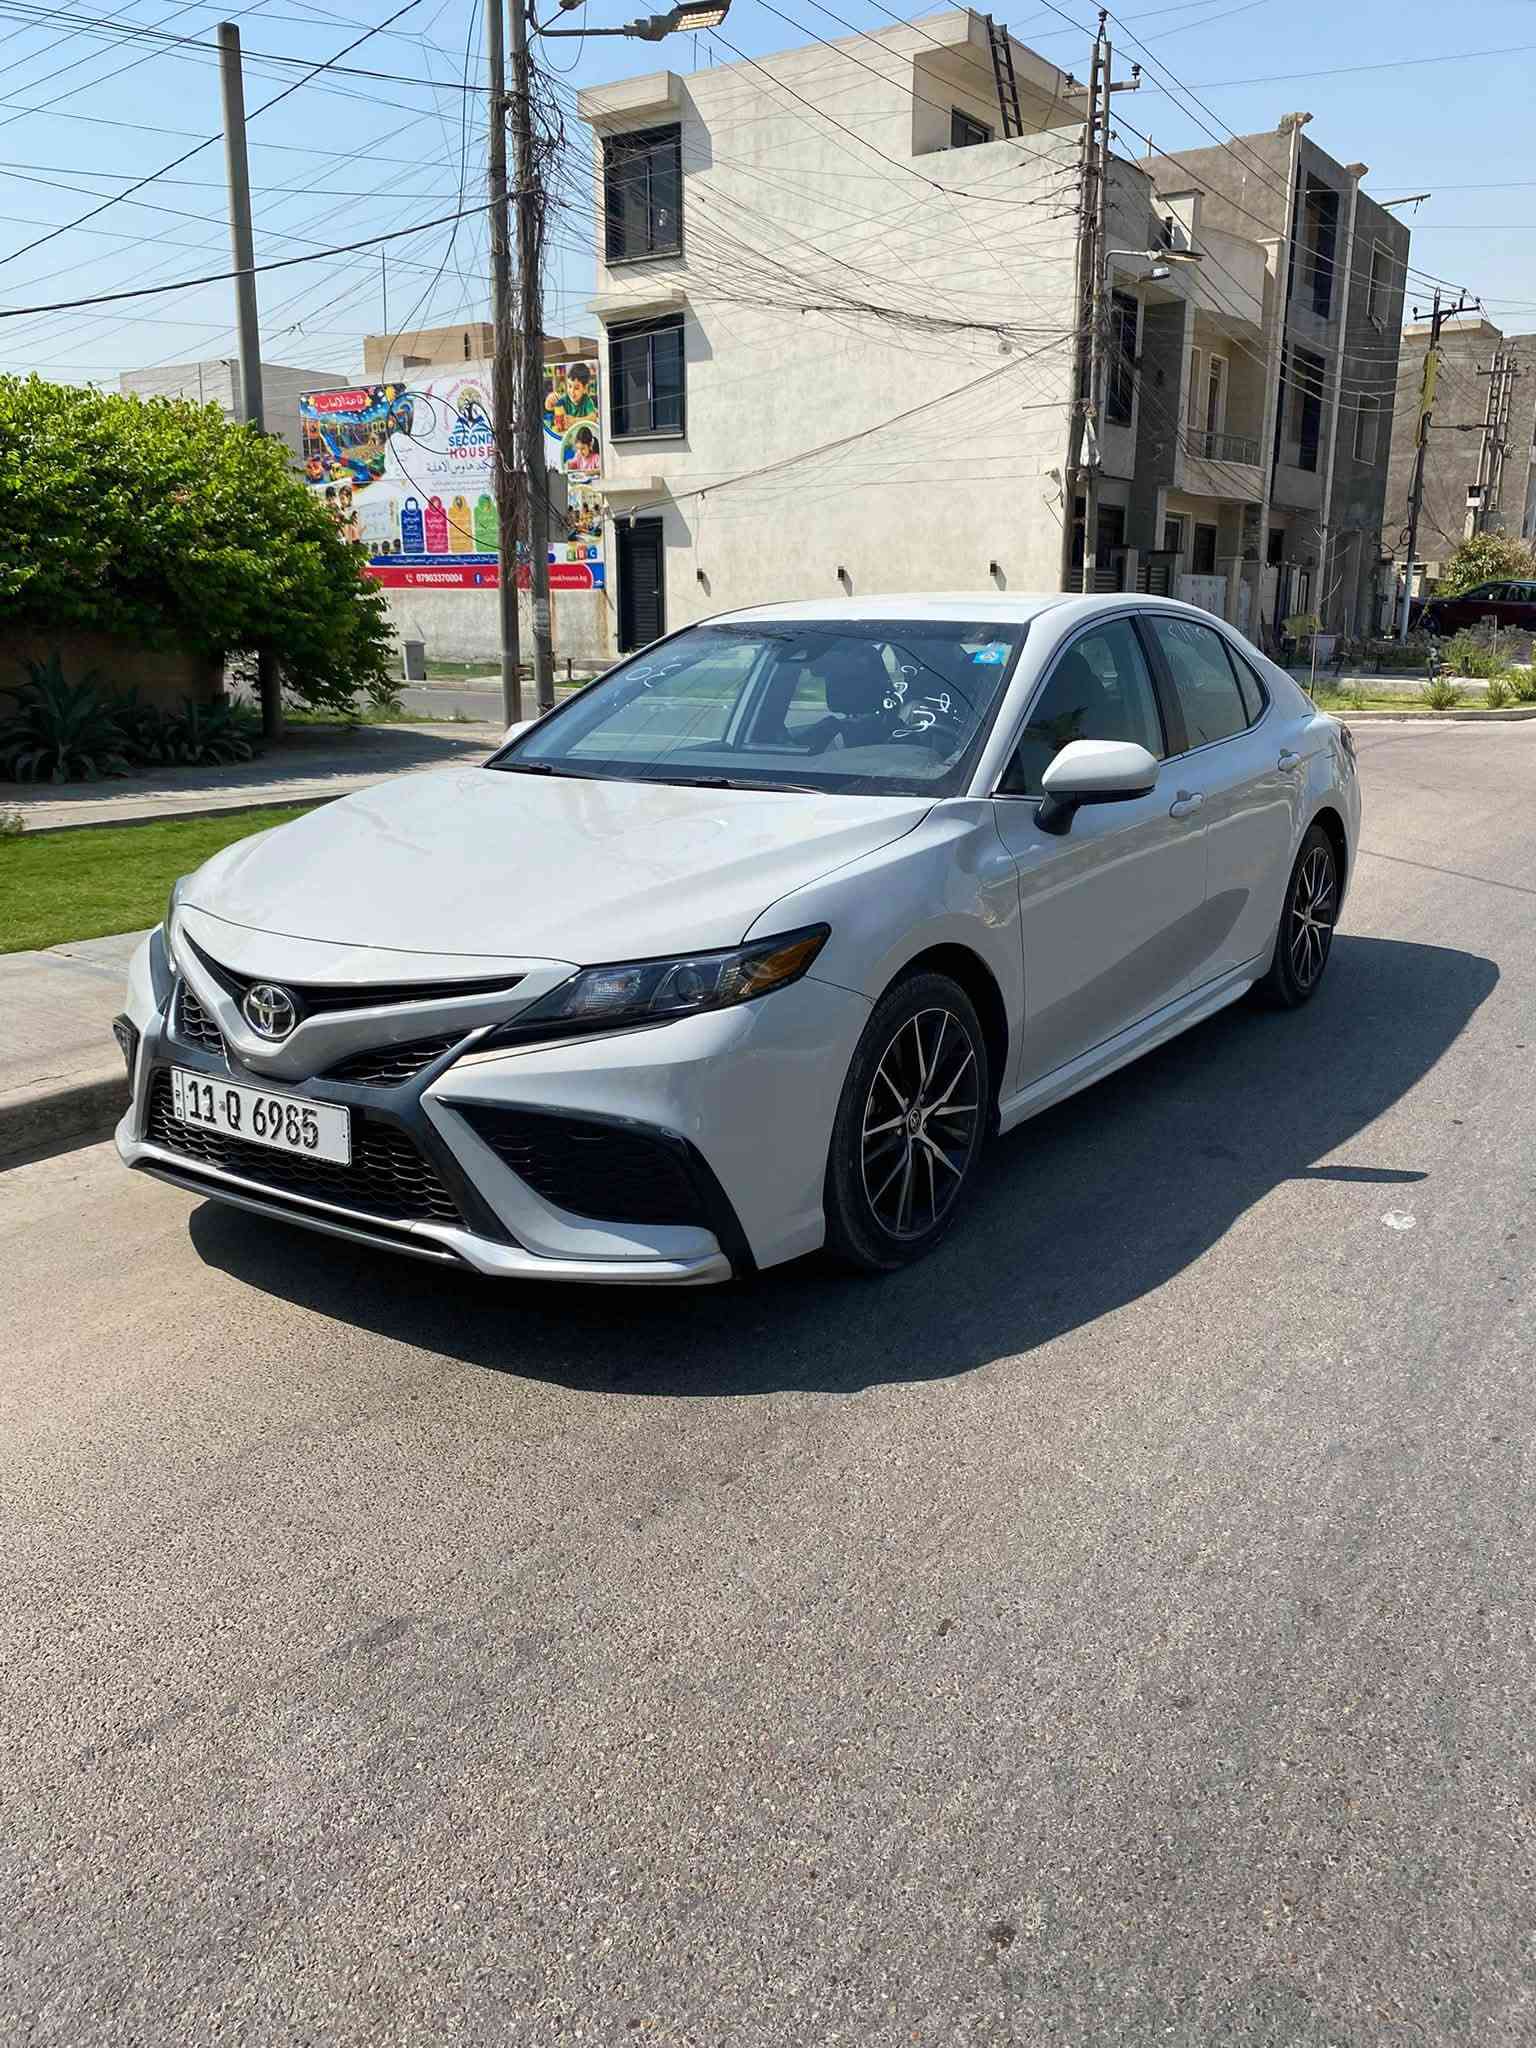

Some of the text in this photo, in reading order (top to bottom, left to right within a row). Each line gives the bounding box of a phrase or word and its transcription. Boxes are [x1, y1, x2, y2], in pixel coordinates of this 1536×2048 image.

[449, 446, 496, 458] HOUSE
[188, 1080, 319, 1149] 11 Q 6985
